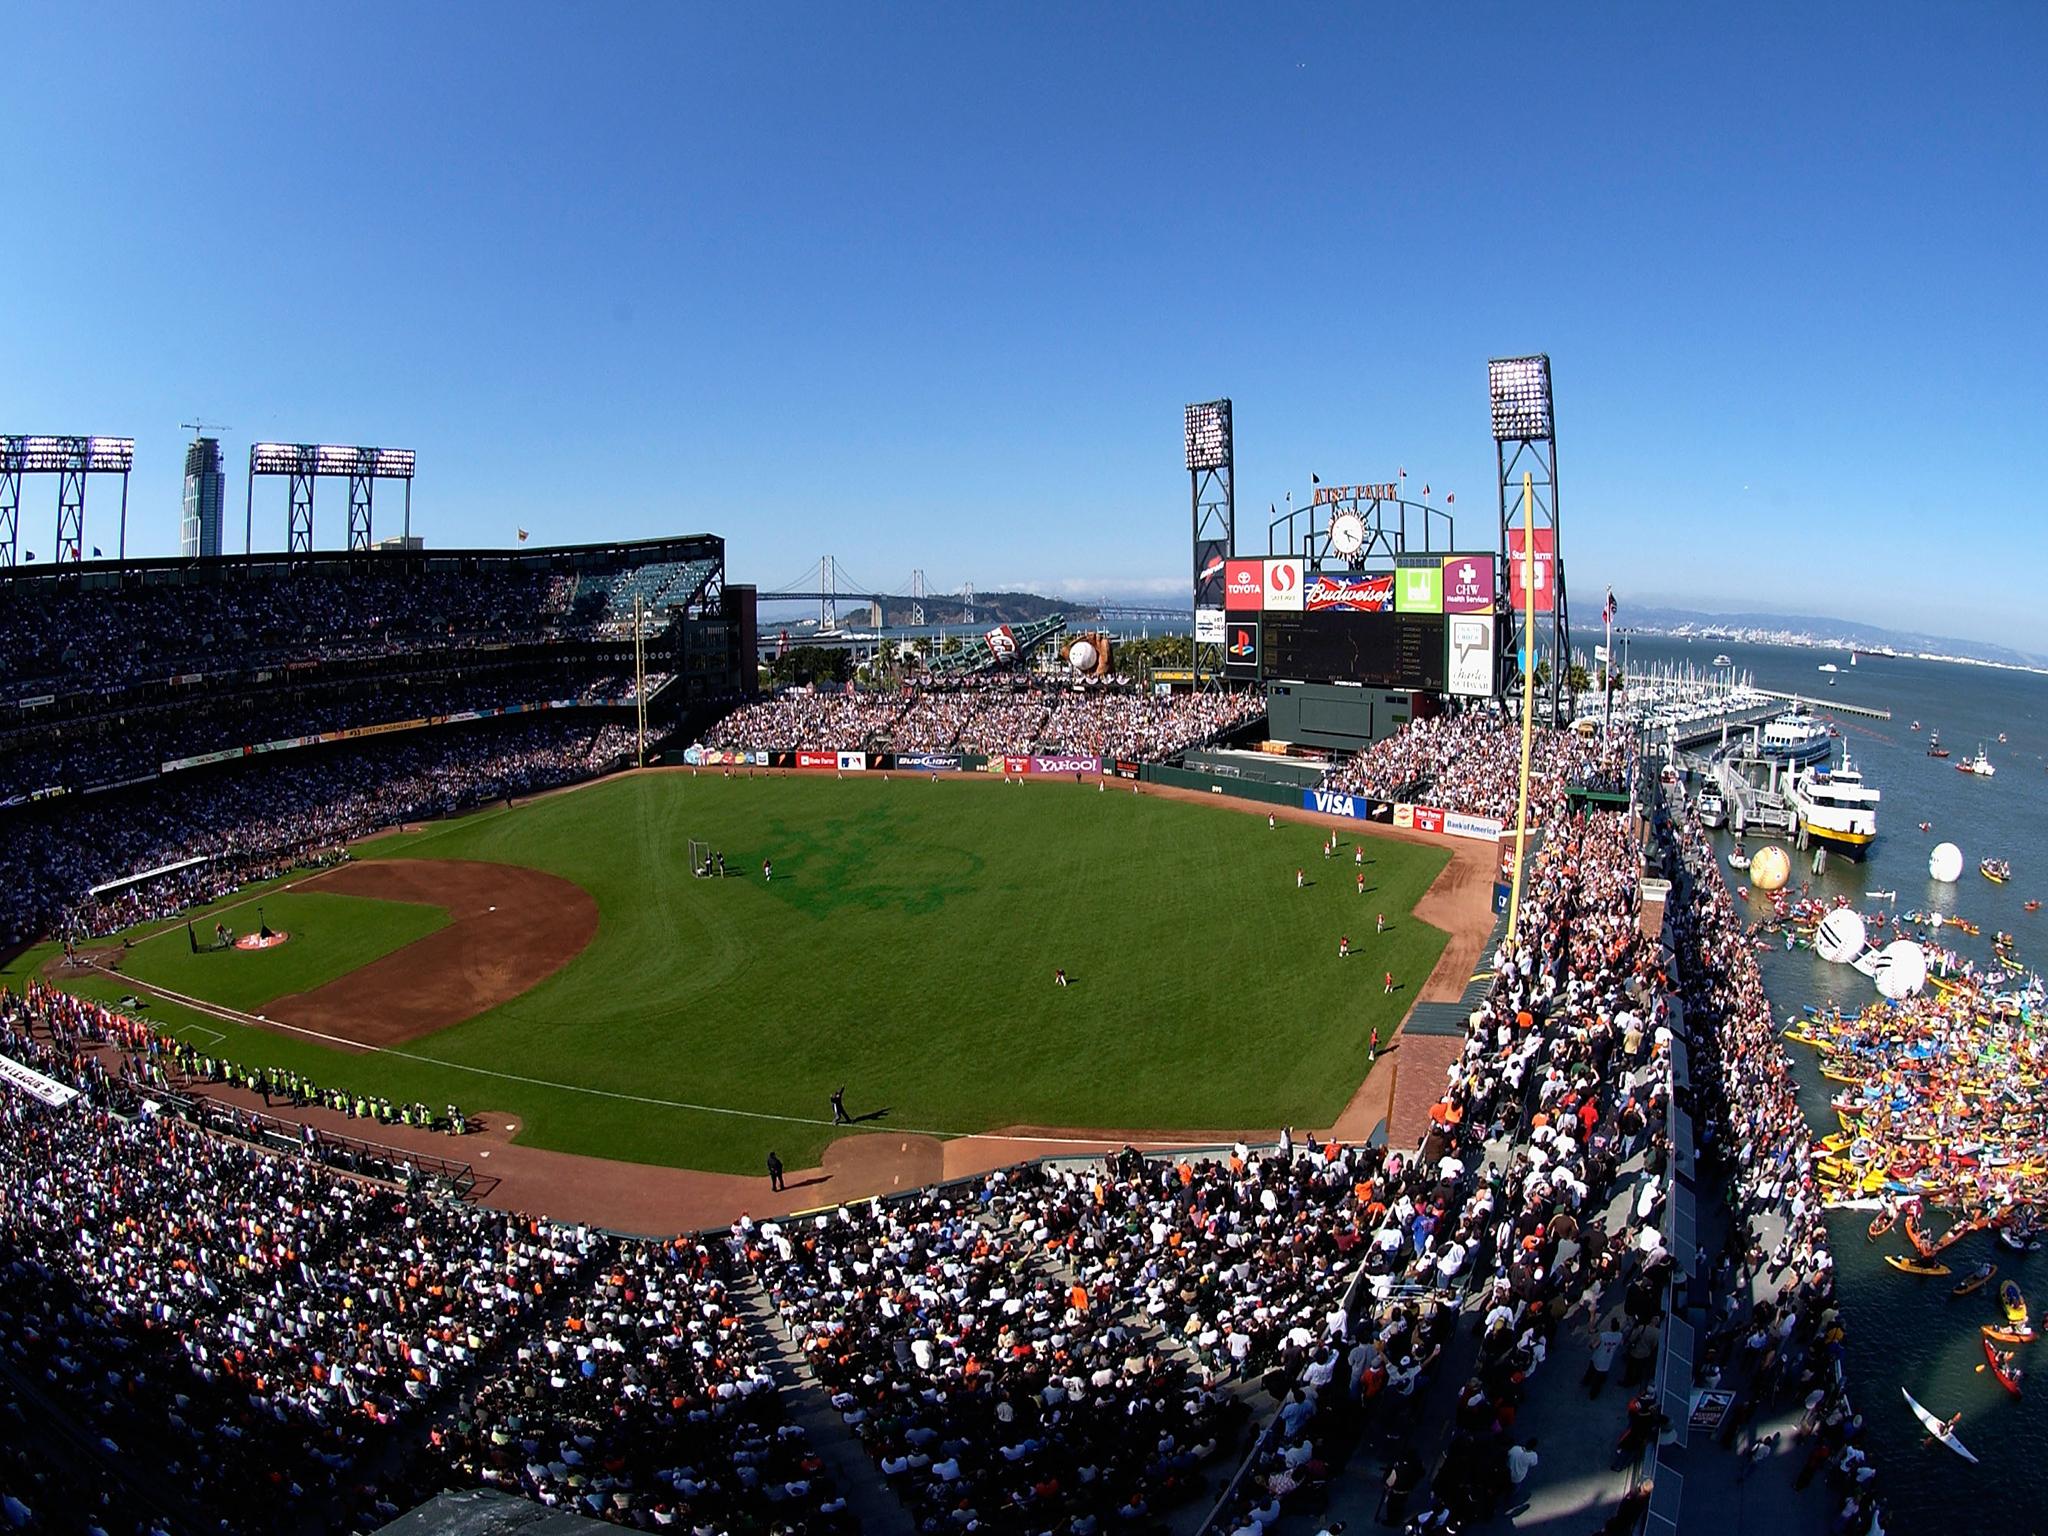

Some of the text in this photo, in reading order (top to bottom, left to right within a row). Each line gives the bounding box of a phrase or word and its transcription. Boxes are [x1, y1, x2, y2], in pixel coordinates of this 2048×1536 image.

[1313, 483, 1397, 506] AT&T PARK
[1512, 549, 1527, 560] Stat
[1228, 584, 1261, 595] TOYOTA
[1304, 582, 1393, 602] Budweiser
[1455, 584, 1480, 596] CHW
[898, 757, 958, 766] BUD LIGHT
[1036, 758, 1097, 773] YAHOO!
[1313, 791, 1355, 817] VISA
[1447, 820, 1497, 836] Bank of America
[8, 1069, 45, 1089] LEAGUE
